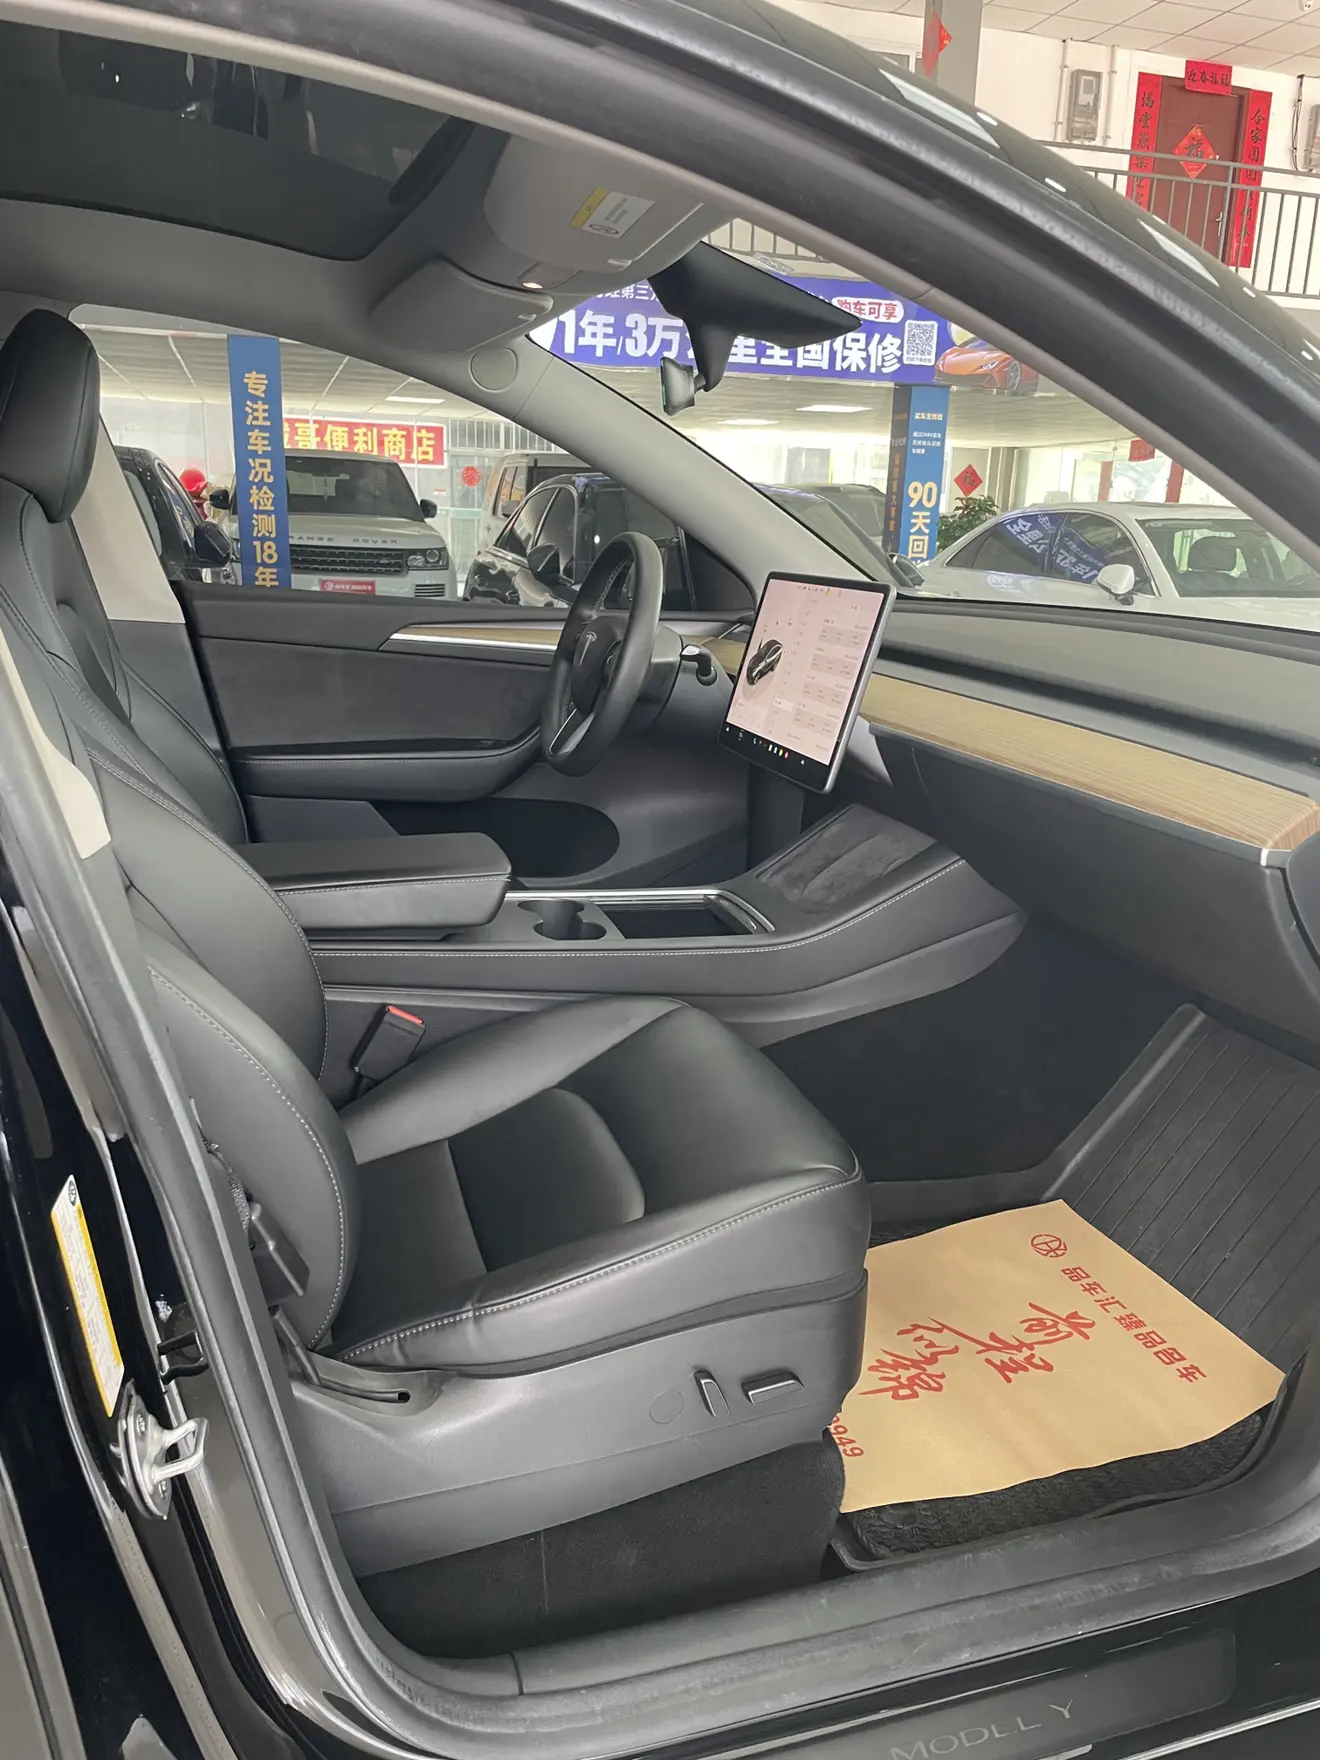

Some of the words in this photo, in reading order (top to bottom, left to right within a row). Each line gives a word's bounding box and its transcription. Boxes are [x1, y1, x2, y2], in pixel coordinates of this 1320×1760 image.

[557, 309, 902, 374] 1年/3万里全国保修
[837, 300, 898, 320] 购车可享
[243, 370, 280, 588] 专注车况检测18年
[352, 537, 398, 545] ROVER
[907, 481, 938, 565] 90天回
[1061, 1266, 1207, 1383] 品车汇臻品名车
[1049, 1698, 1074, 1719] Y
